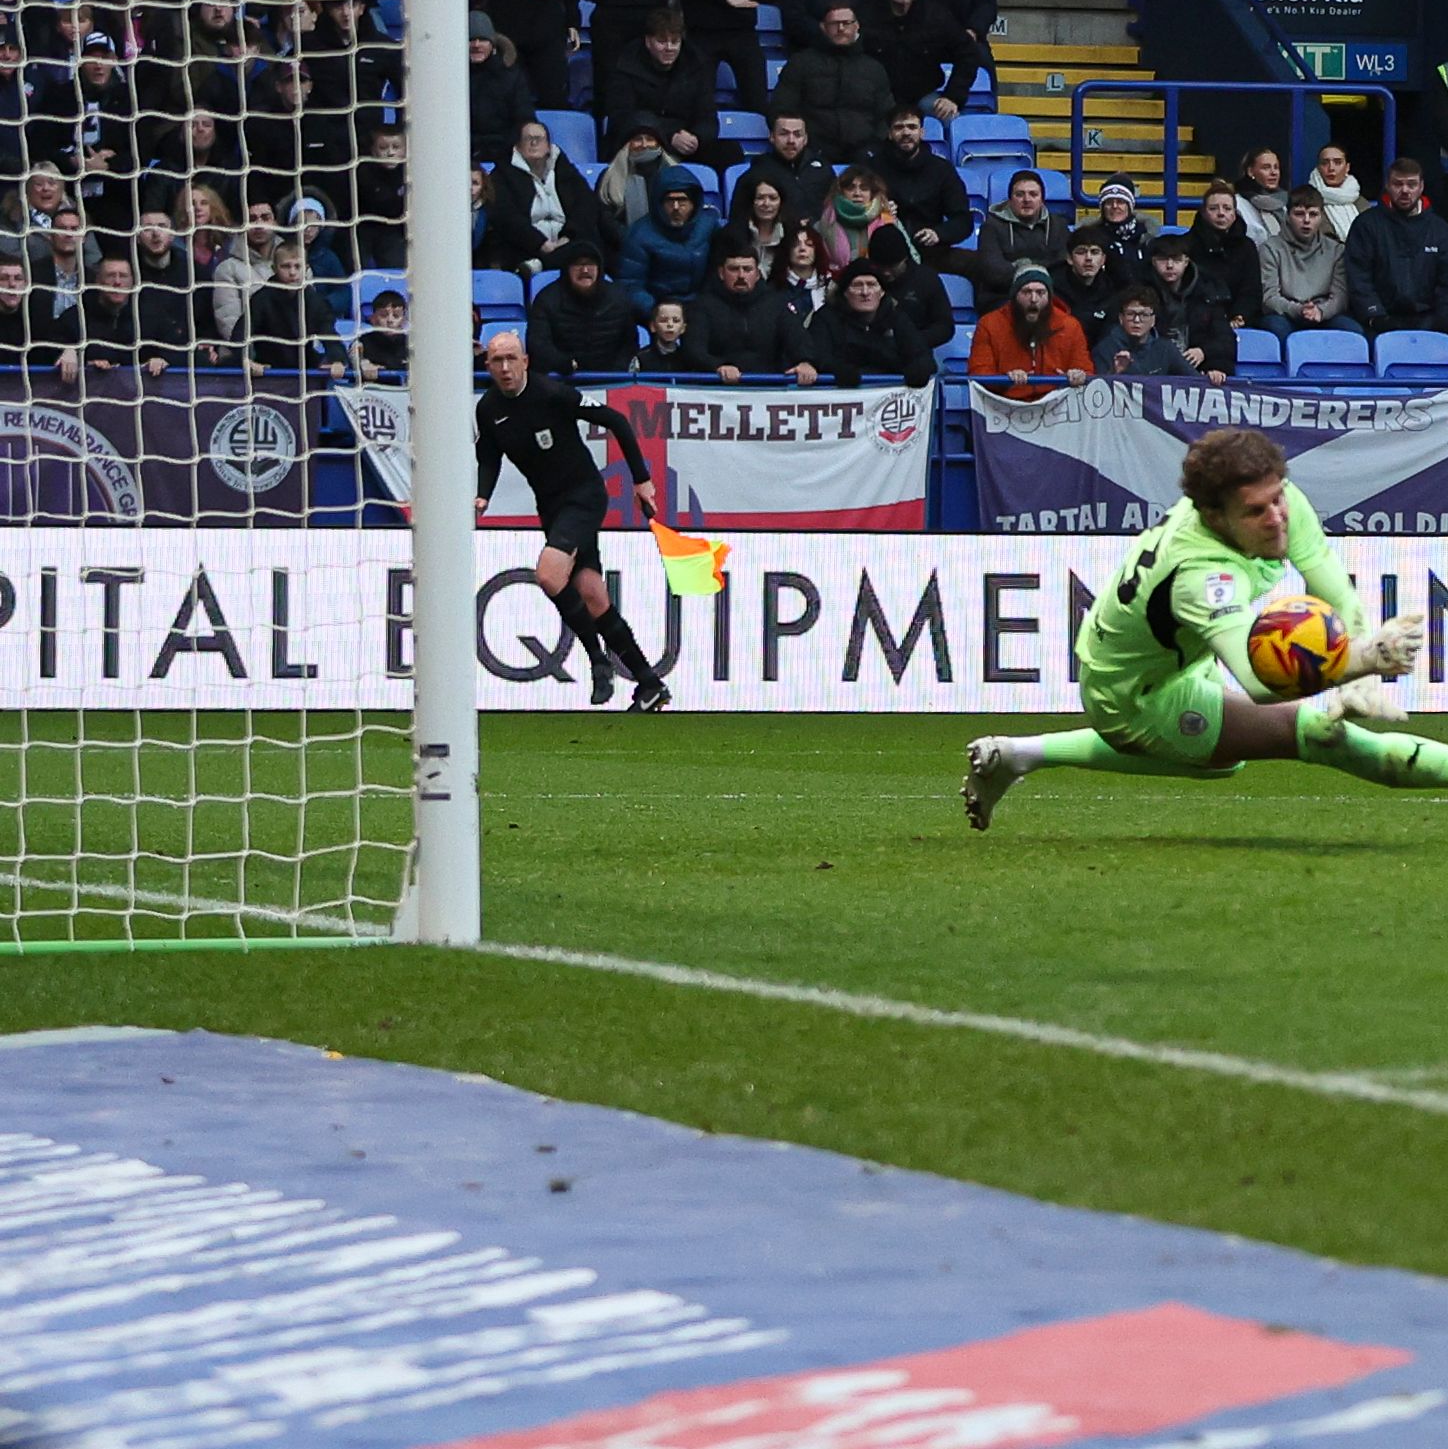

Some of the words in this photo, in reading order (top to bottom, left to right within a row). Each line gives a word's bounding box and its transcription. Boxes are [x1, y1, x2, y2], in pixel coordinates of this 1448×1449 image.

[1329, 7, 1362, 16] Dealer
[1357, 54, 1394, 71] WL3
[1051, 75, 1062, 88] L
[1088, 132, 1100, 146] K
[986, 378, 1143, 434] BOLTON
[1162, 383, 1432, 434] WANDERERS
